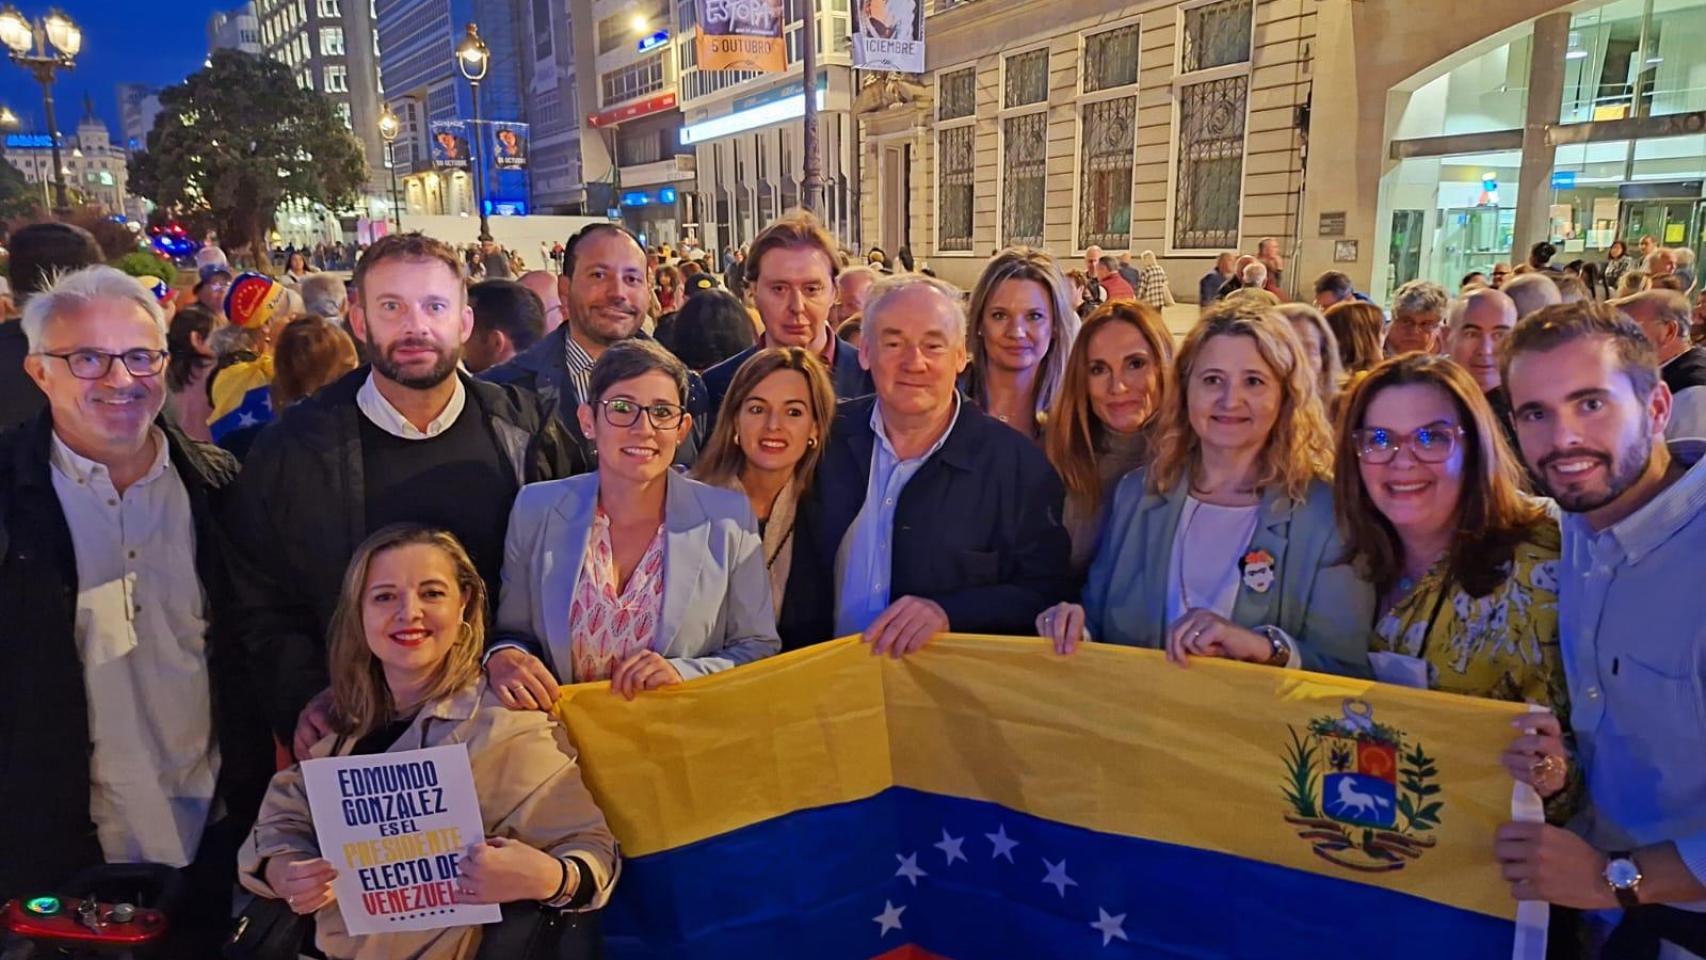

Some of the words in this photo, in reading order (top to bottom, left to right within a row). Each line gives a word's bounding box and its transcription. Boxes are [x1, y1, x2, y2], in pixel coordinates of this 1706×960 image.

[705, 0, 769, 31] ESTOPA
[711, 40, 719, 53] 5
[721, 39, 771, 55] OUTUBRO
[866, 40, 915, 55] ICIEMBRE
[337, 760, 439, 798] EDMUNDO
[342, 787, 448, 827] GONZÁLEZ
[379, 821, 400, 837] ES
[402, 819, 420, 834] EL
[342, 826, 463, 869] PRESIDENTE
[358, 857, 434, 892] ELECTO
[436, 853, 460, 879] DE
[361, 881, 458, 916] VENEZUEL
